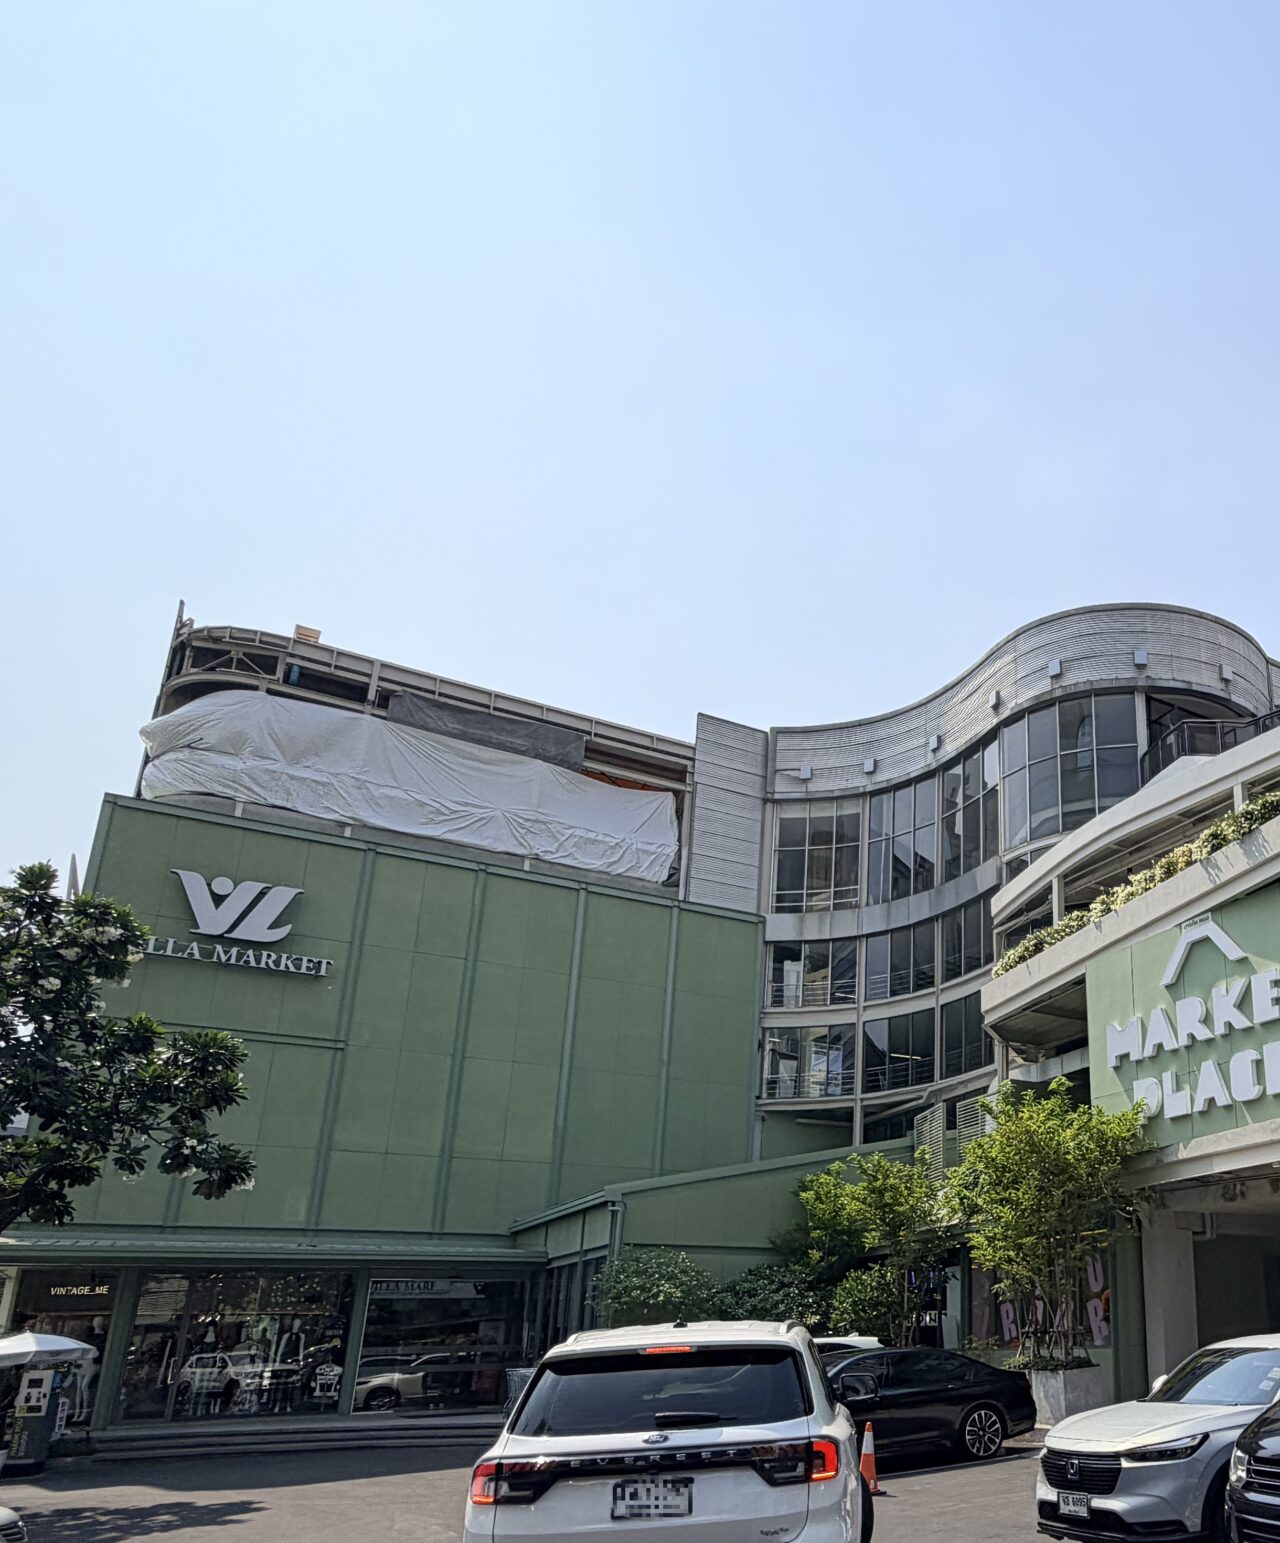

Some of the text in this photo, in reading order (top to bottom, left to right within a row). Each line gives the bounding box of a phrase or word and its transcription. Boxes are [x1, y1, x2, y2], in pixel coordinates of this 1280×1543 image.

[144, 935, 334, 976] LLA MARKET
[570, 1450, 737, 1468] EVEREST
